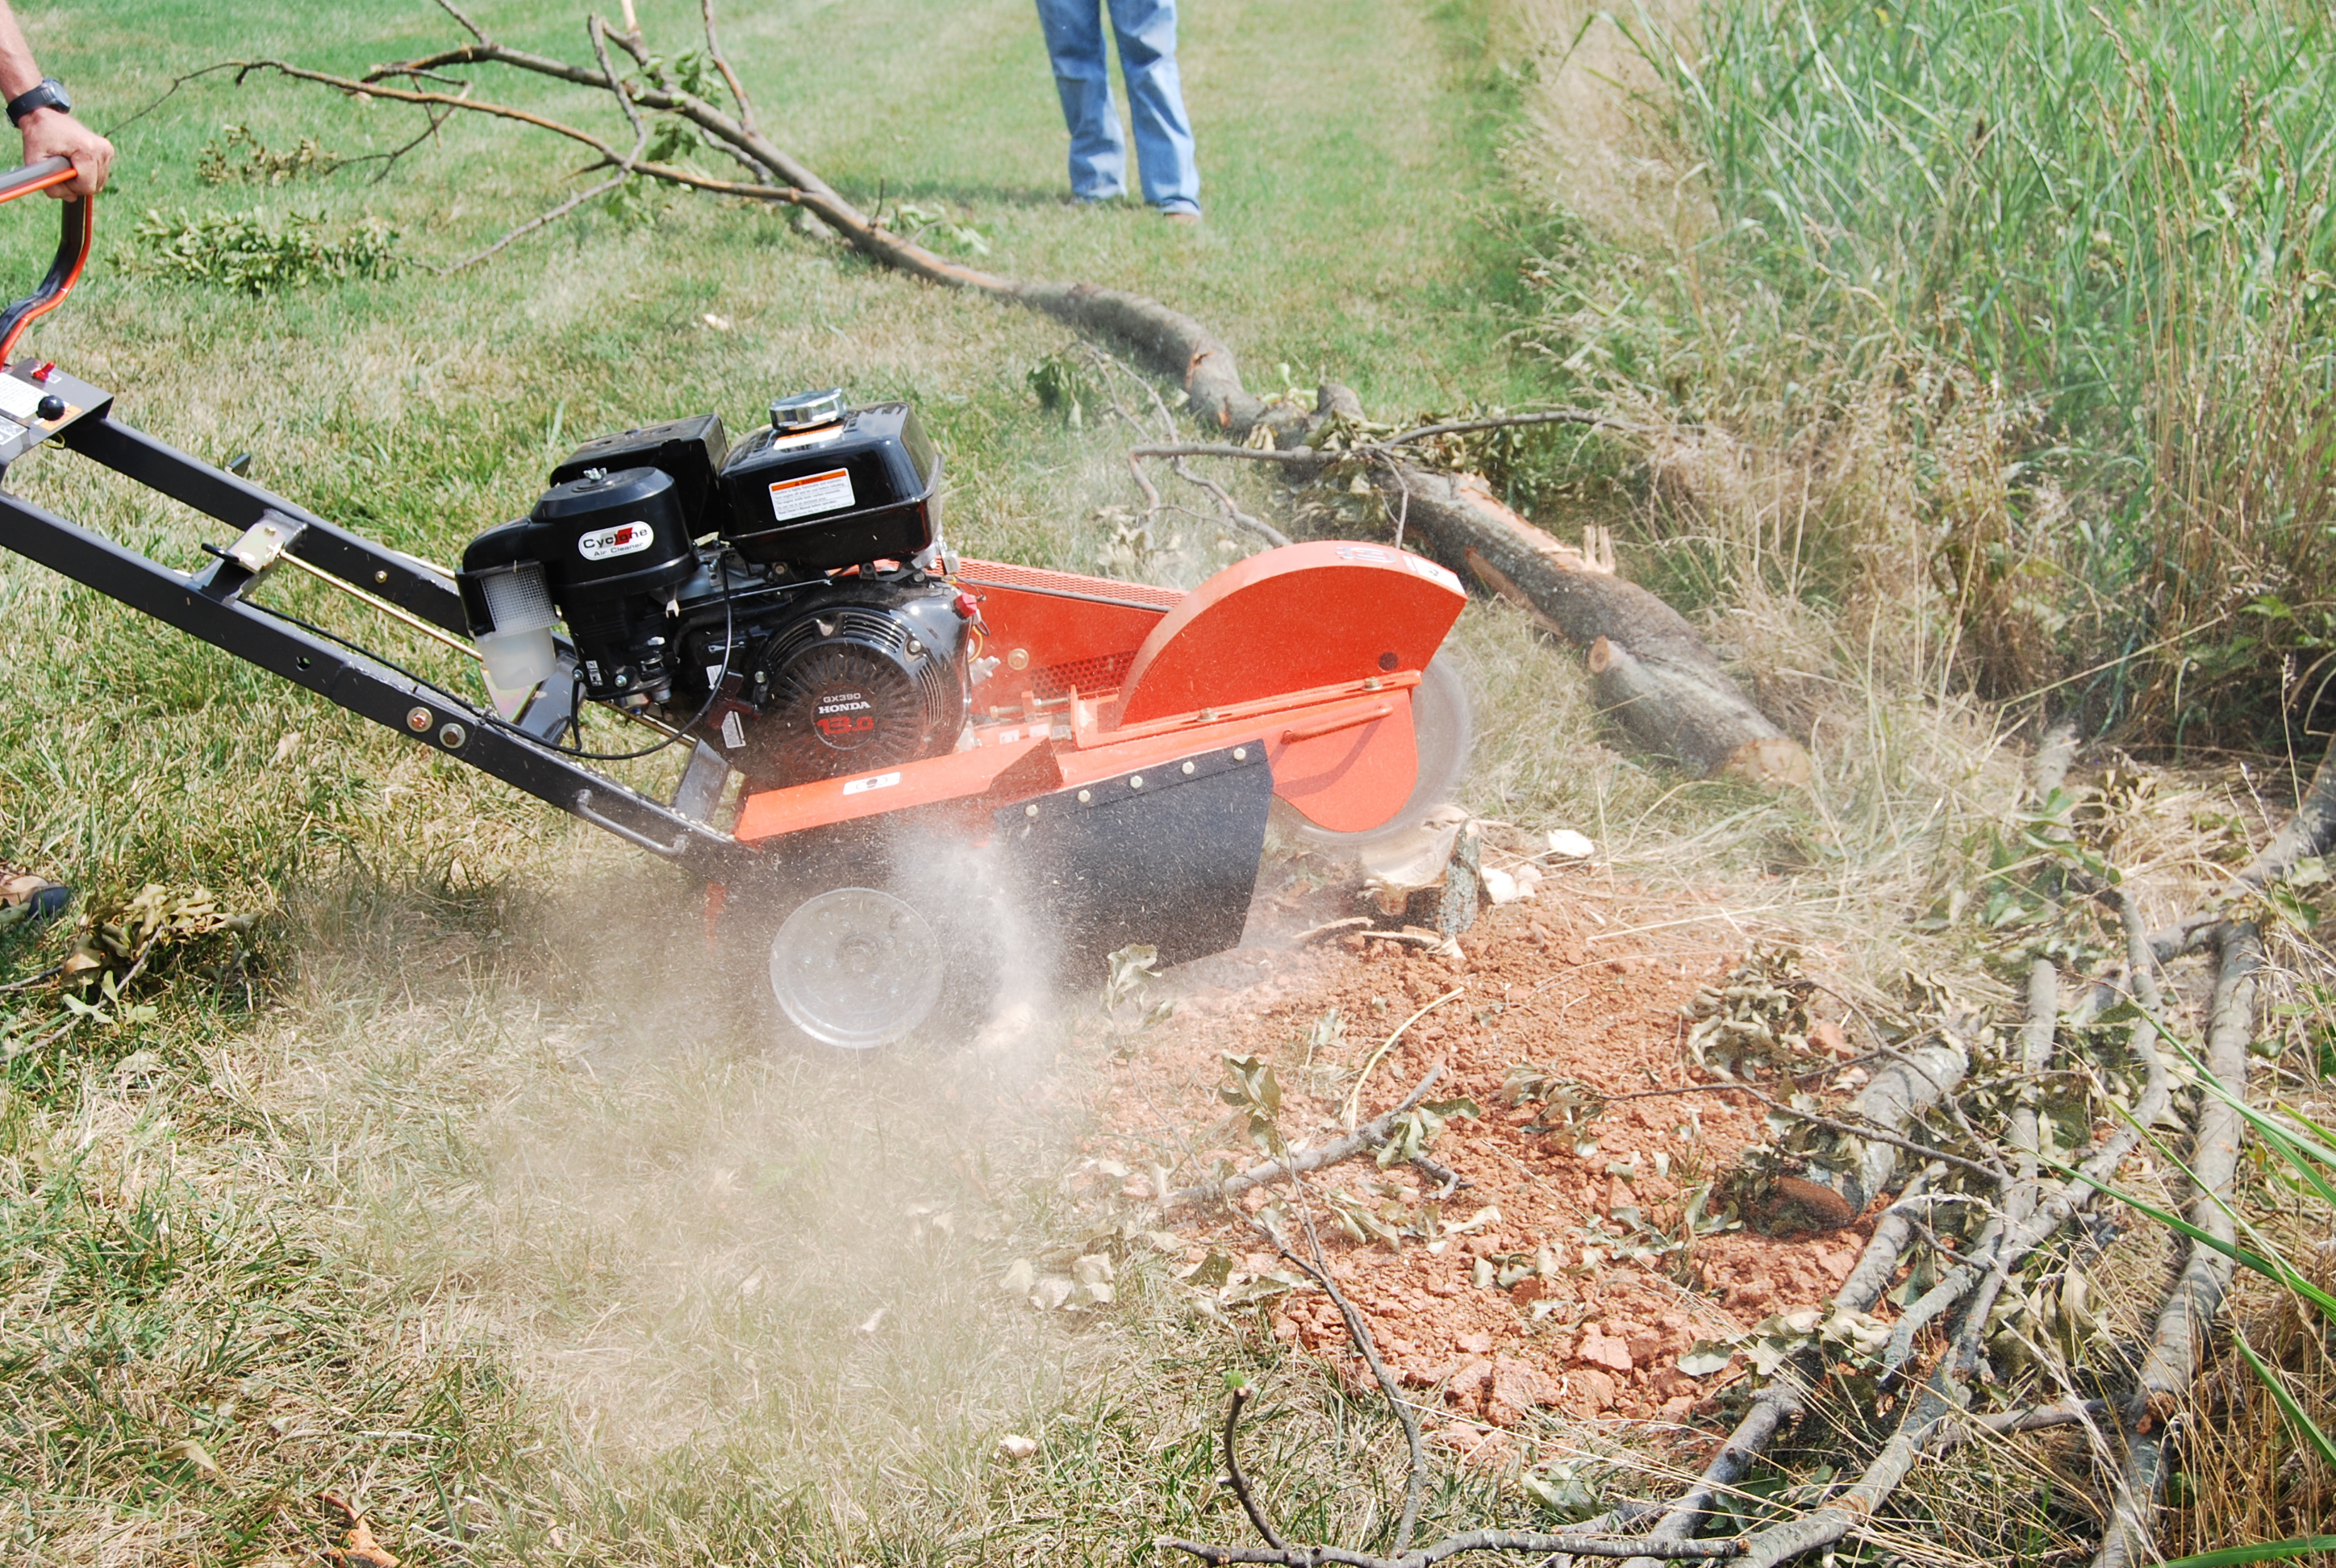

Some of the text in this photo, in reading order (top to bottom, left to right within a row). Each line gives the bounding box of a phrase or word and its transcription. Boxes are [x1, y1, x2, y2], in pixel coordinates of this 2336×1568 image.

[583, 529, 647, 548] Cyclone
[611, 542, 644, 553] Cleaner
[823, 693, 861, 703] GX390
[818, 701, 871, 714] HONDA
[817, 716, 874, 735] 13.0
